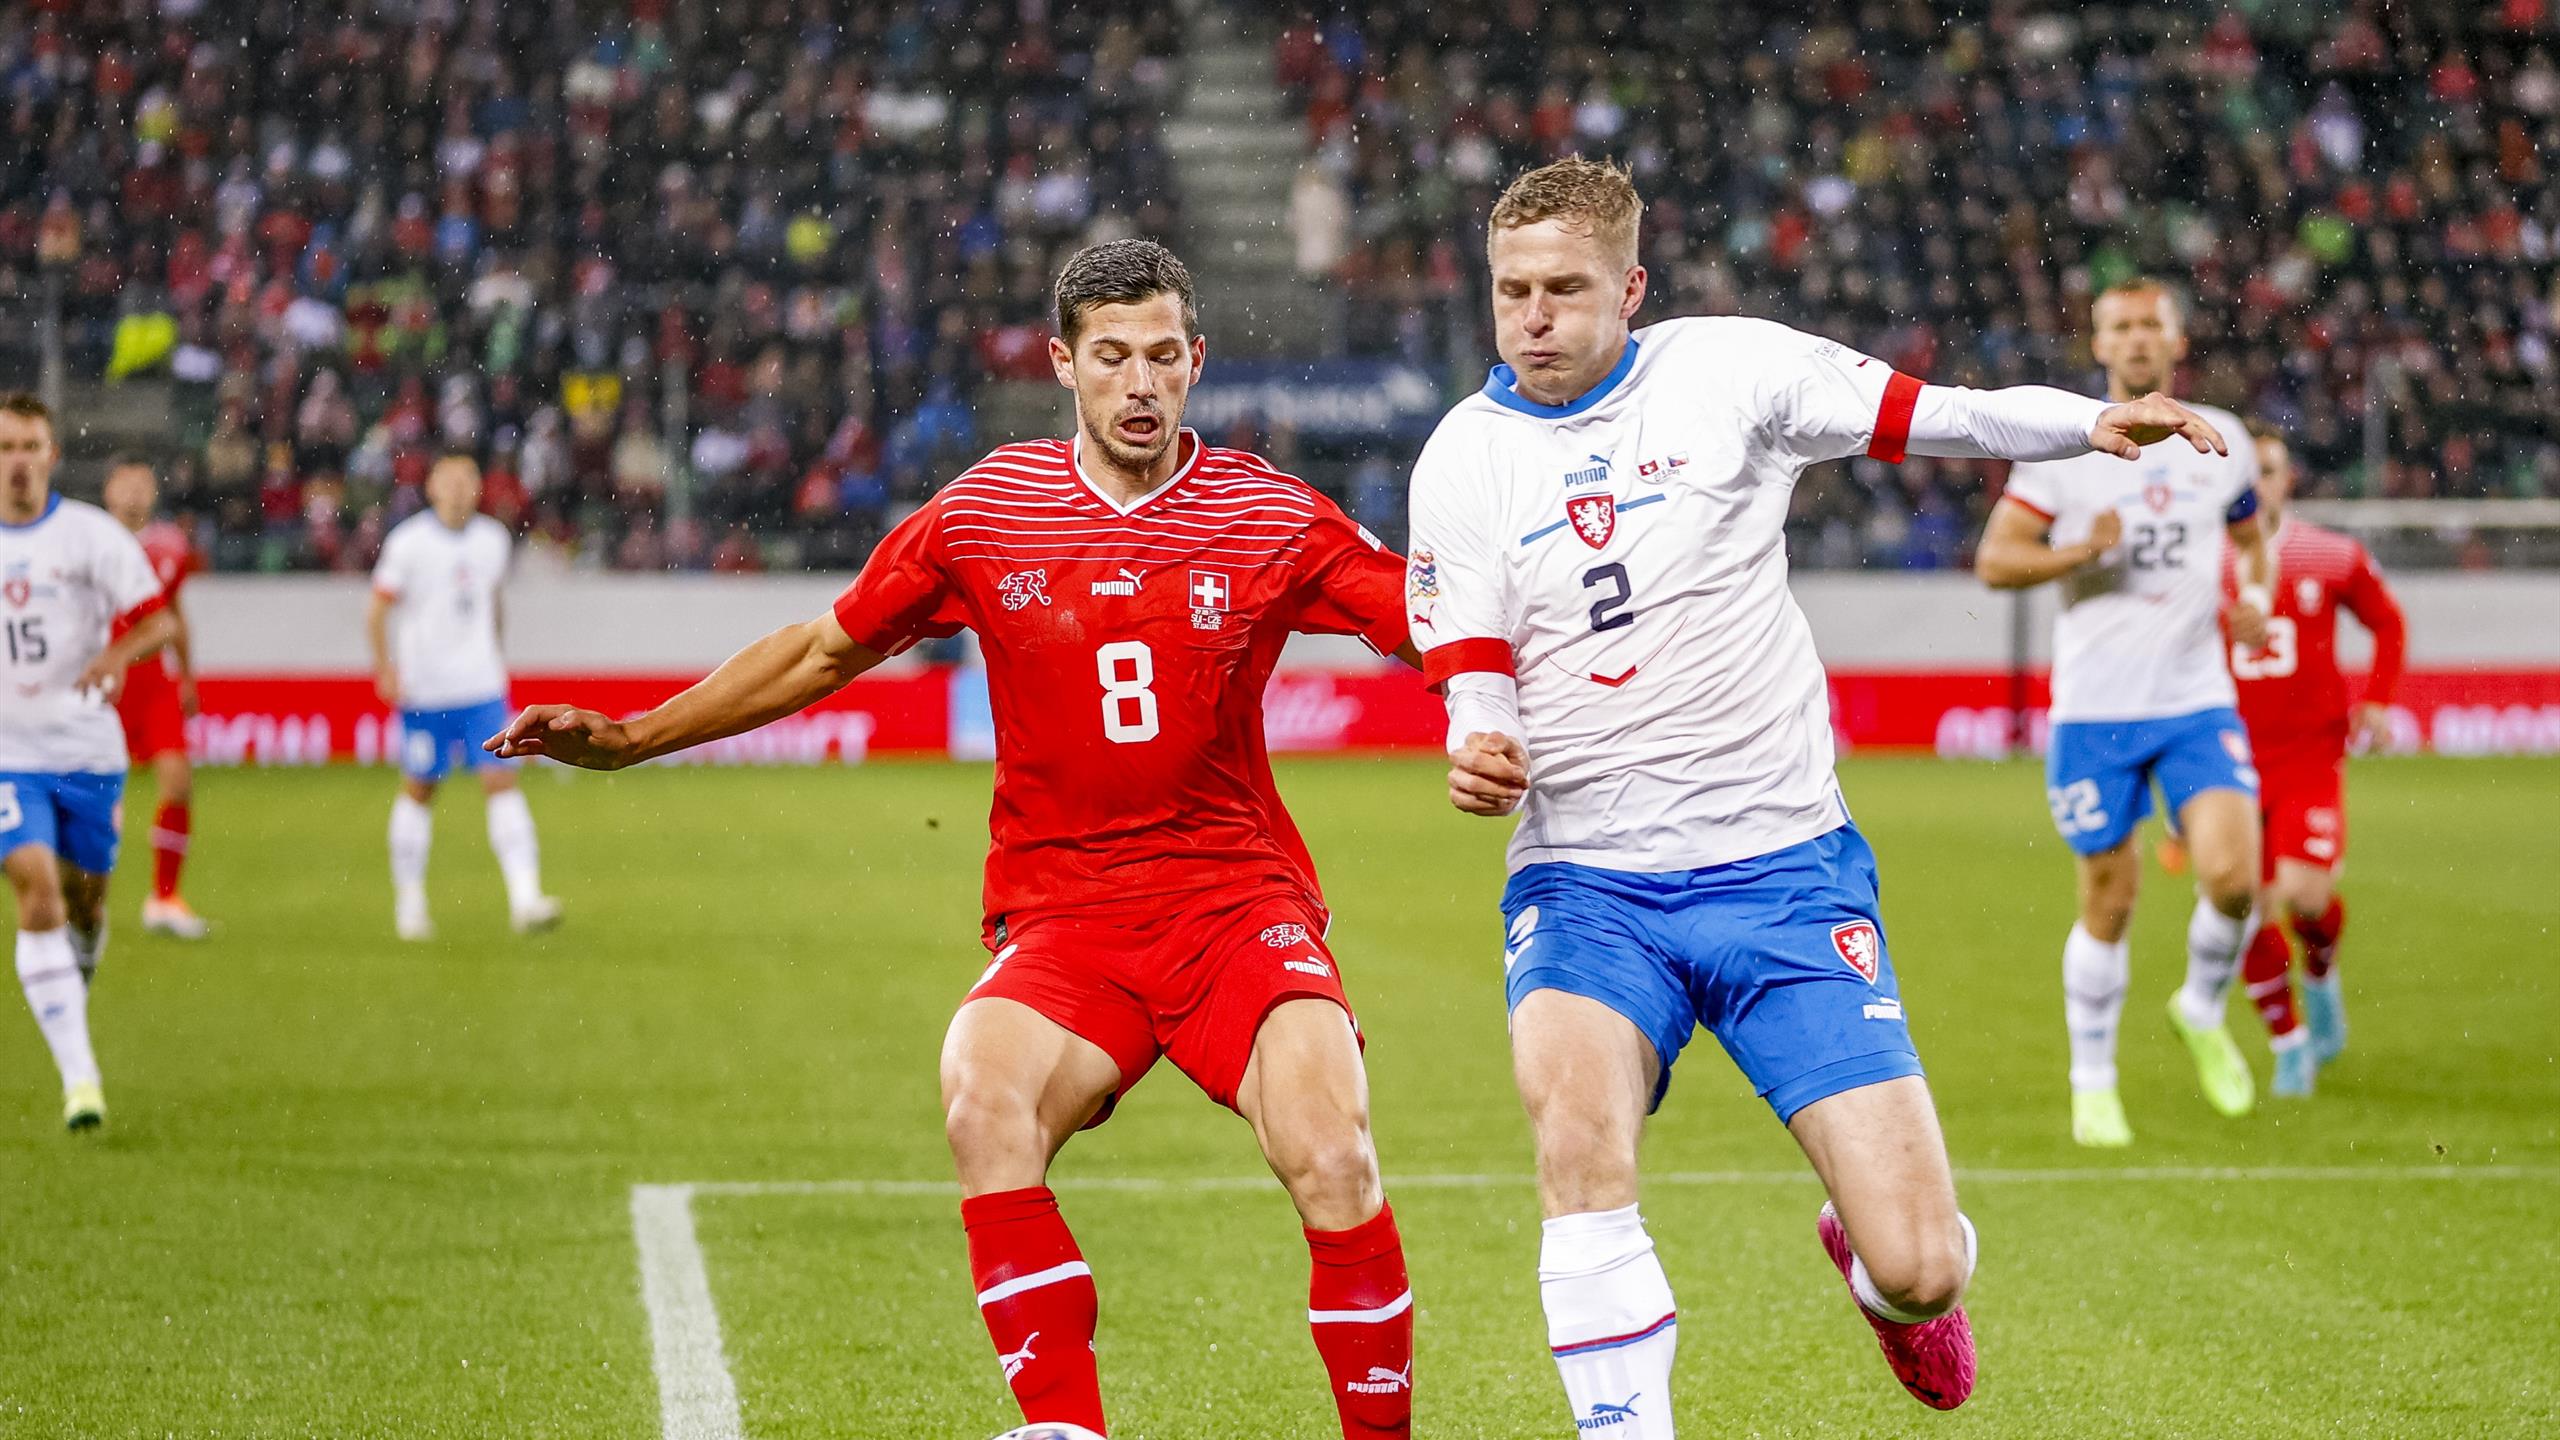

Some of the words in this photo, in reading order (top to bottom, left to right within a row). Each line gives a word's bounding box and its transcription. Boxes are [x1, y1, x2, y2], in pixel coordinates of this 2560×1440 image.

[1564, 466, 1608, 487] PUMA
[2132, 522, 2186, 569] 22
[1091, 581, 1134, 596] PUMA
[1582, 562, 1632, 632] 2
[7, 617, 47, 663] 15
[1096, 641, 1160, 743] 8
[1283, 961, 1328, 977] PUMA
[1347, 1381, 1399, 1394] PUMA
[1577, 1412, 1624, 1429] PUMA
